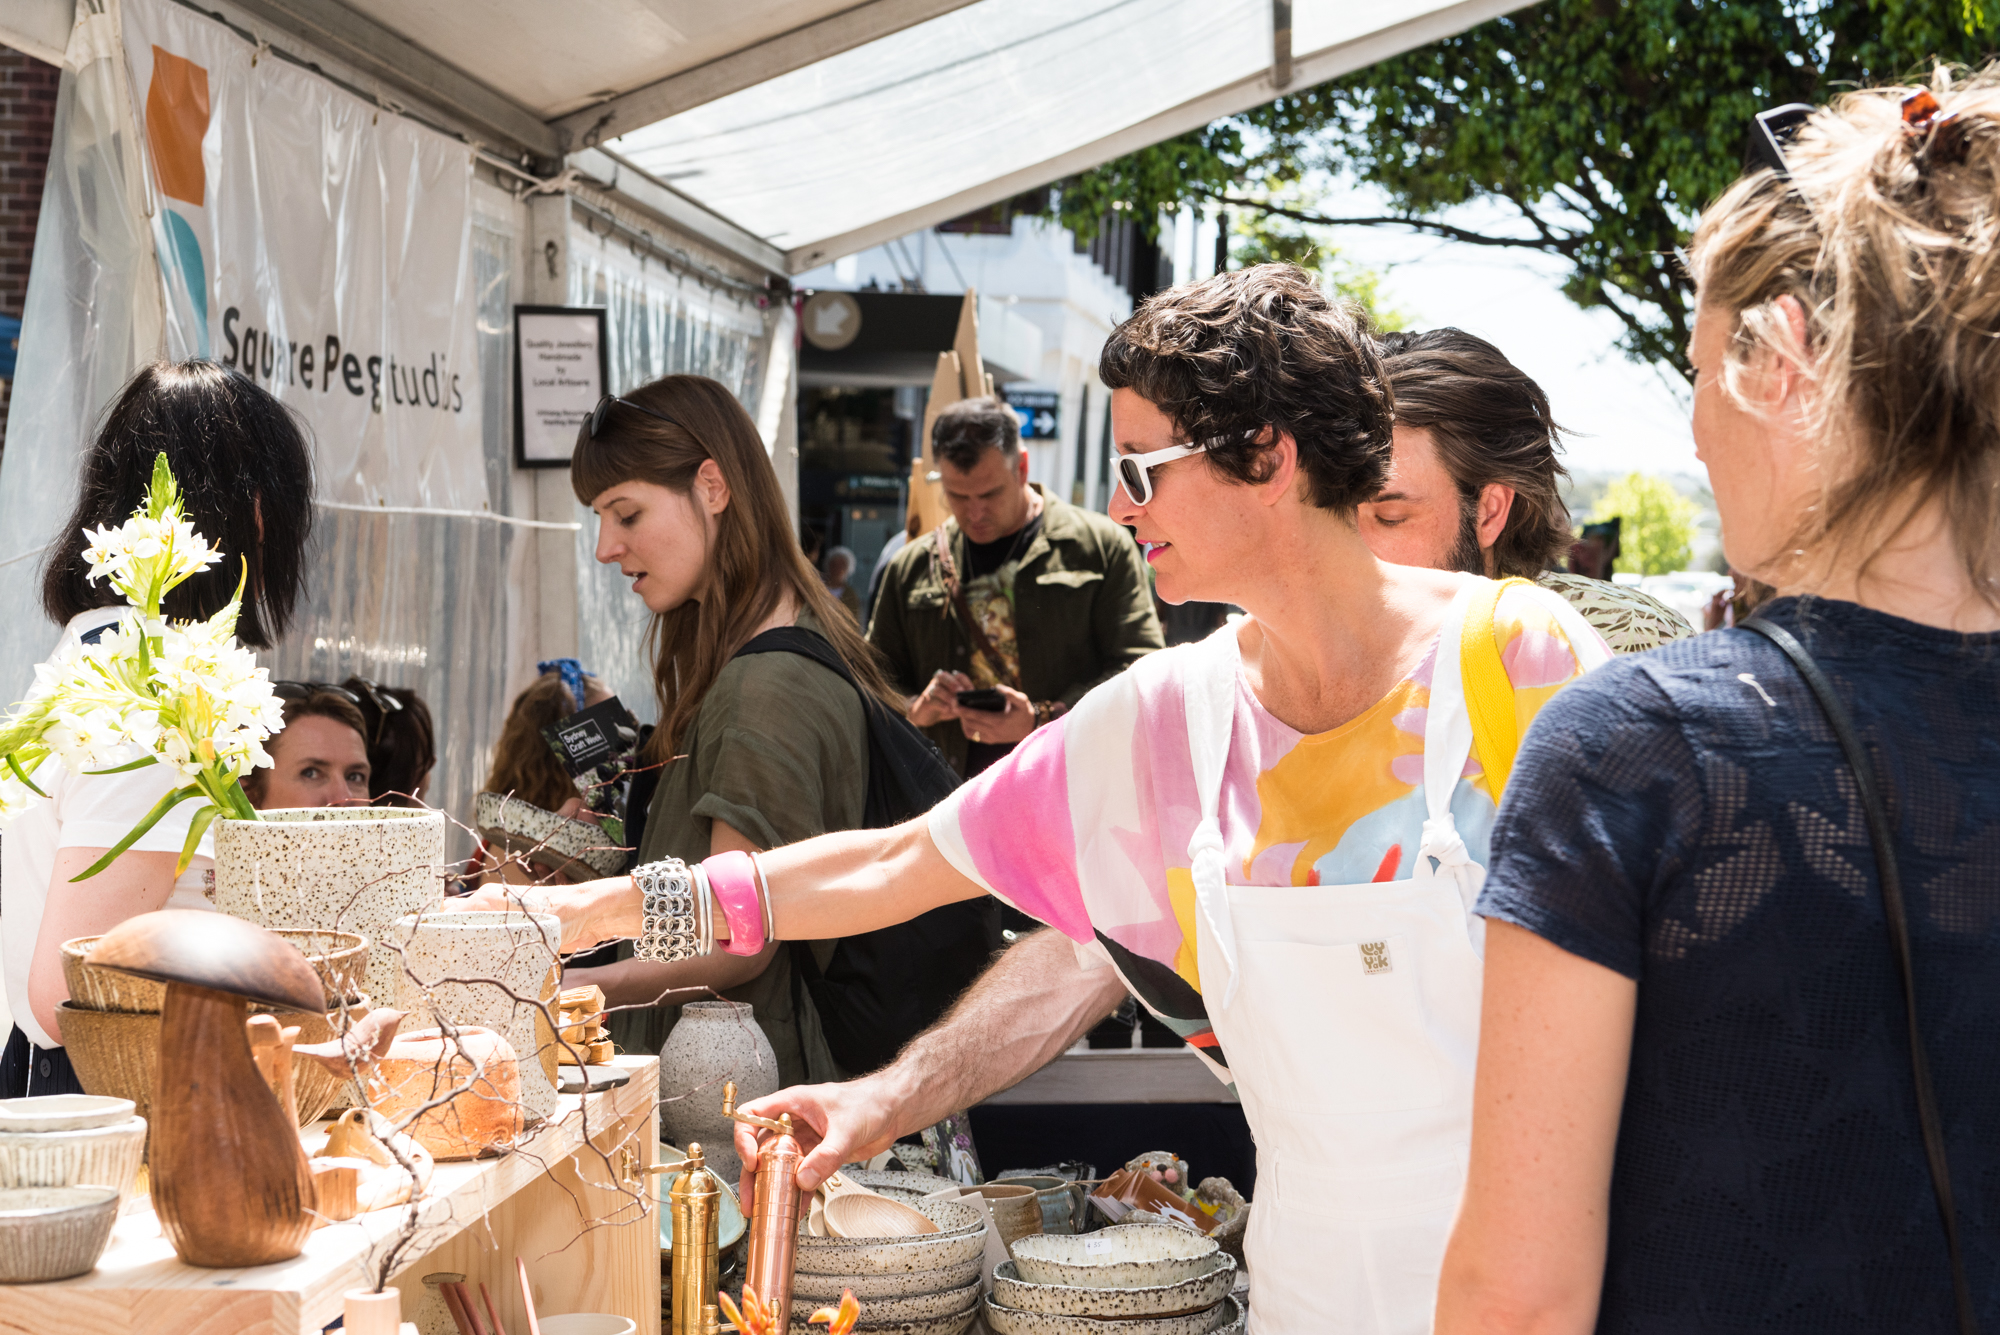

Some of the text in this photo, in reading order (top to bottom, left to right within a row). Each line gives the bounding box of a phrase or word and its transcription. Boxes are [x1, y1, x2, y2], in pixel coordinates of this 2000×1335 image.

[223, 306, 314, 389] Squre
[389, 352, 463, 413] tudis
[564, 729, 587, 744] Sydney
[569, 732, 603, 753] Craft Week
